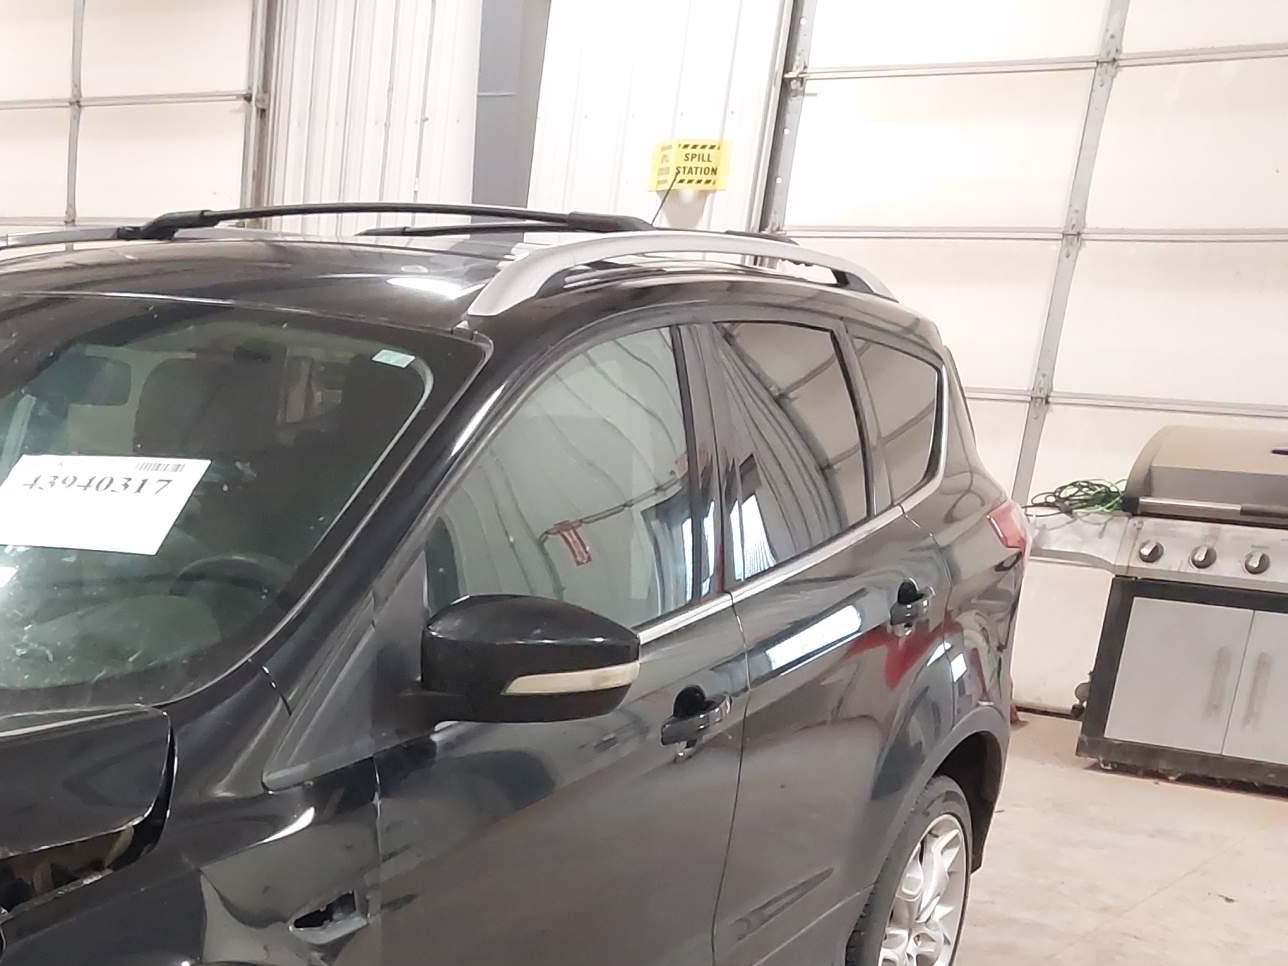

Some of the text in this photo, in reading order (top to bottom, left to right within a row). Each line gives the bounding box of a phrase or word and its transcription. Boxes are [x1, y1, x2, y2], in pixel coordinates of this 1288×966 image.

[683, 152, 713, 163] SPILL
[675, 165, 718, 176] STATION
[23, 474, 173, 495] 43940317
